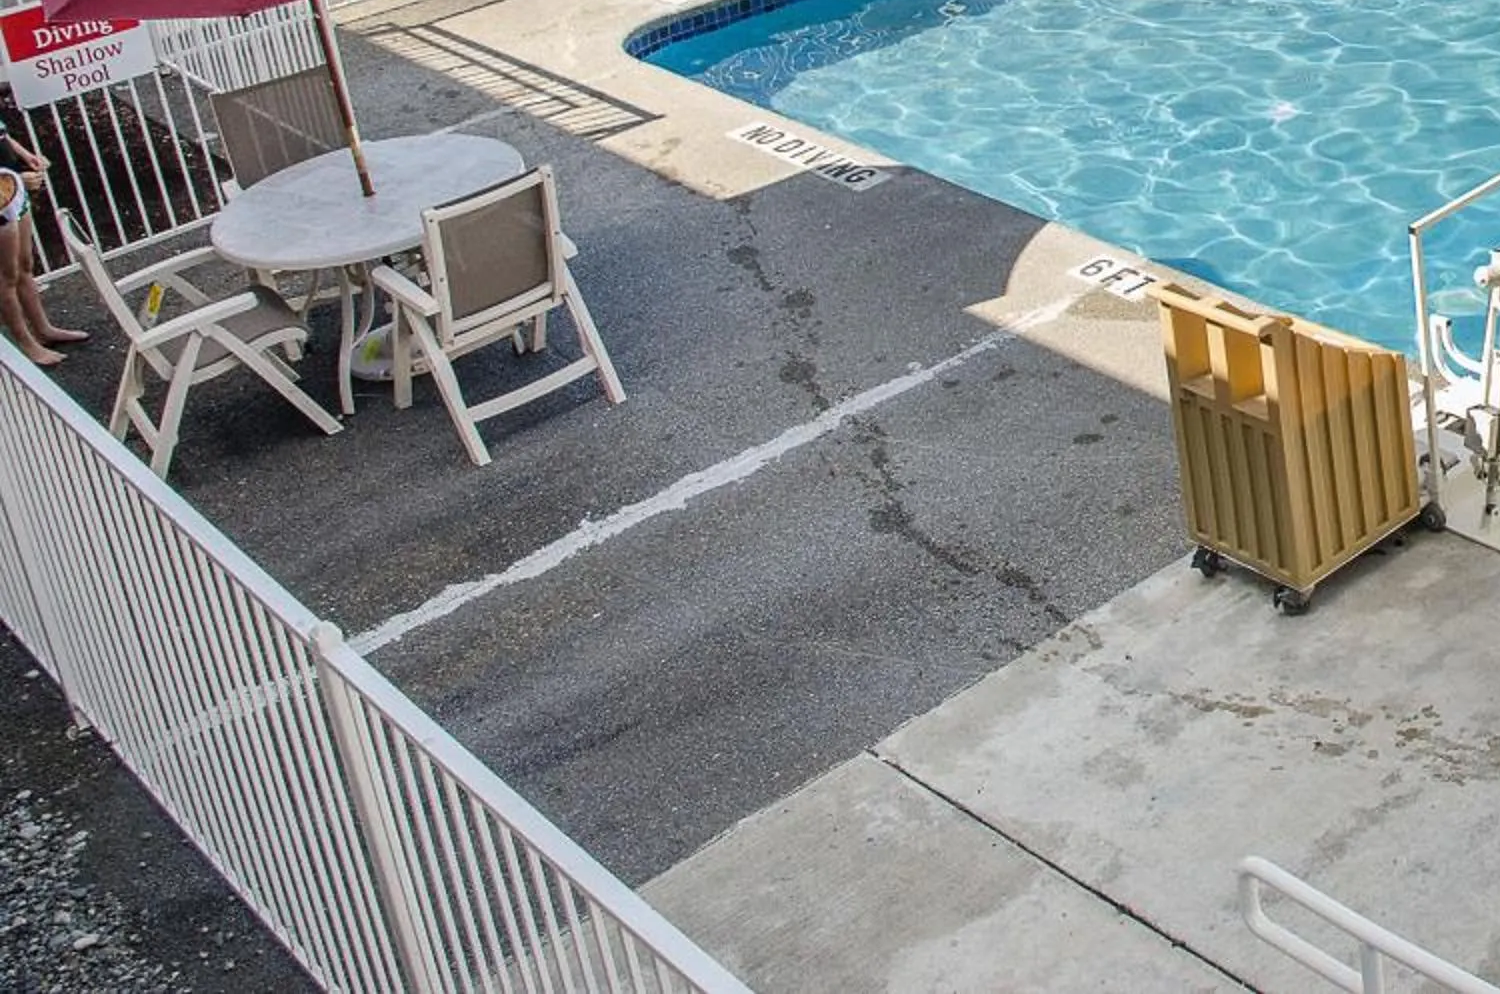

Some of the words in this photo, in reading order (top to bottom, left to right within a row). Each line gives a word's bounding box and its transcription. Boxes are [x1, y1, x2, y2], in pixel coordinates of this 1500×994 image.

[32, 20, 113, 49] Diving
[36, 41, 123, 79] Shallow
[64, 64, 111, 92] Pool
[740, 125, 785, 145] NO
[774, 139, 876, 184] DIVING
